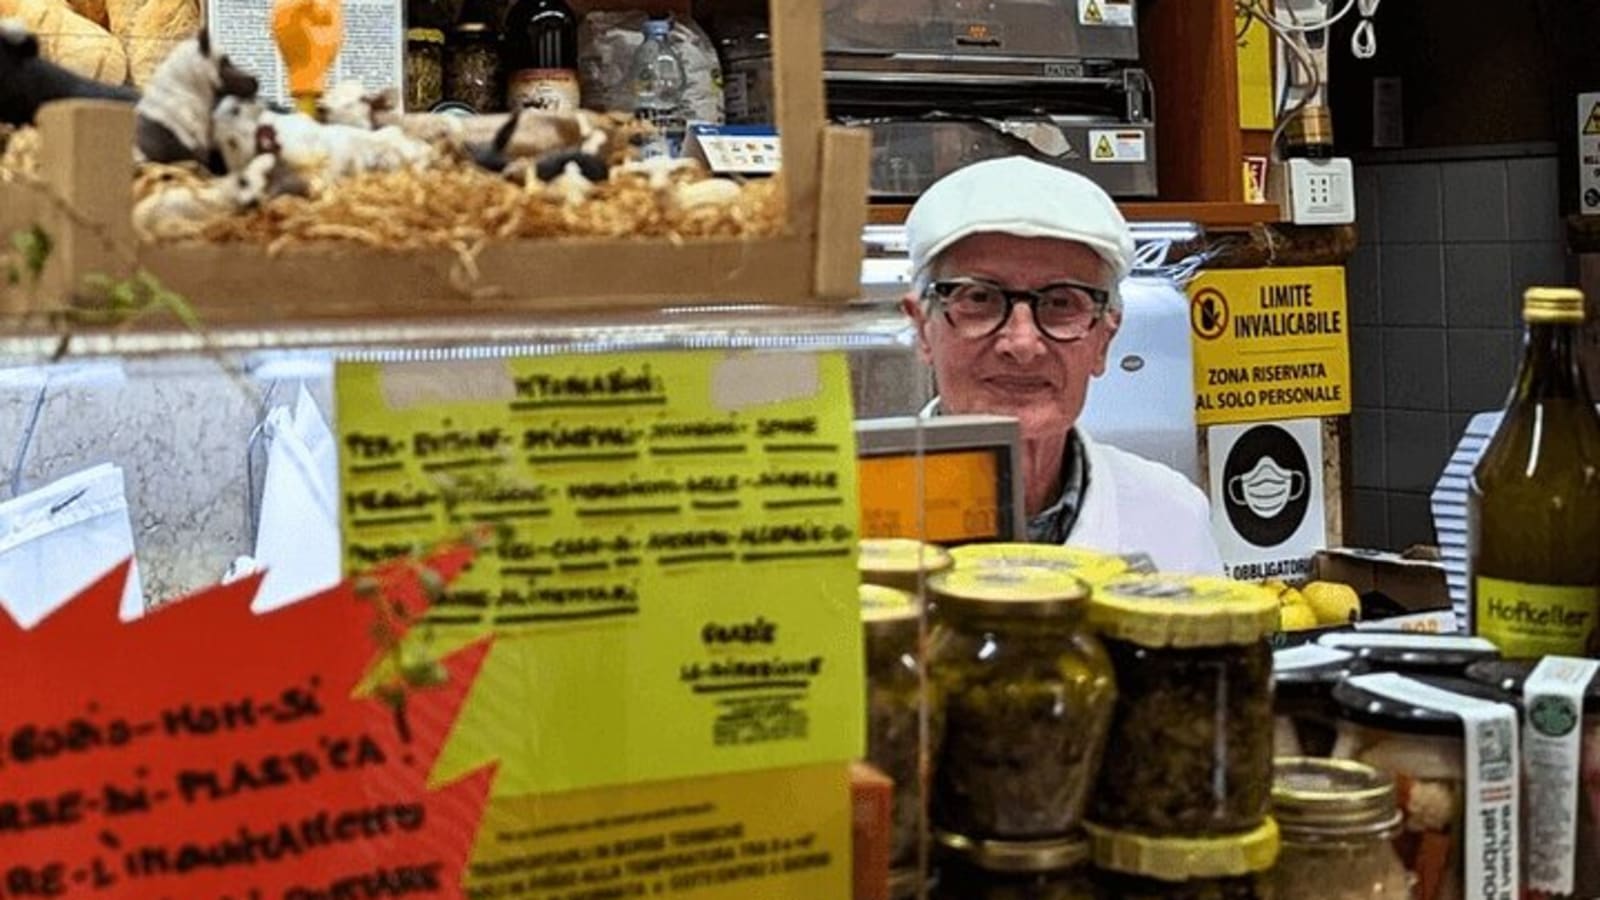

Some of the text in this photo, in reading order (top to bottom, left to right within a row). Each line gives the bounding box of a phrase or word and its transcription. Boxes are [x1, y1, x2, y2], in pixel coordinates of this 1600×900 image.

[1260, 284, 1312, 308] LIMITE
[1234, 311, 1341, 338] INVALICABILE
[1208, 363, 1326, 385] ZONA RISERVATA
[1195, 385, 1341, 411] AL SOLO PERSONALE
[1487, 597, 1588, 626] Hofkeller
[1480, 807, 1498, 900] ouquet
